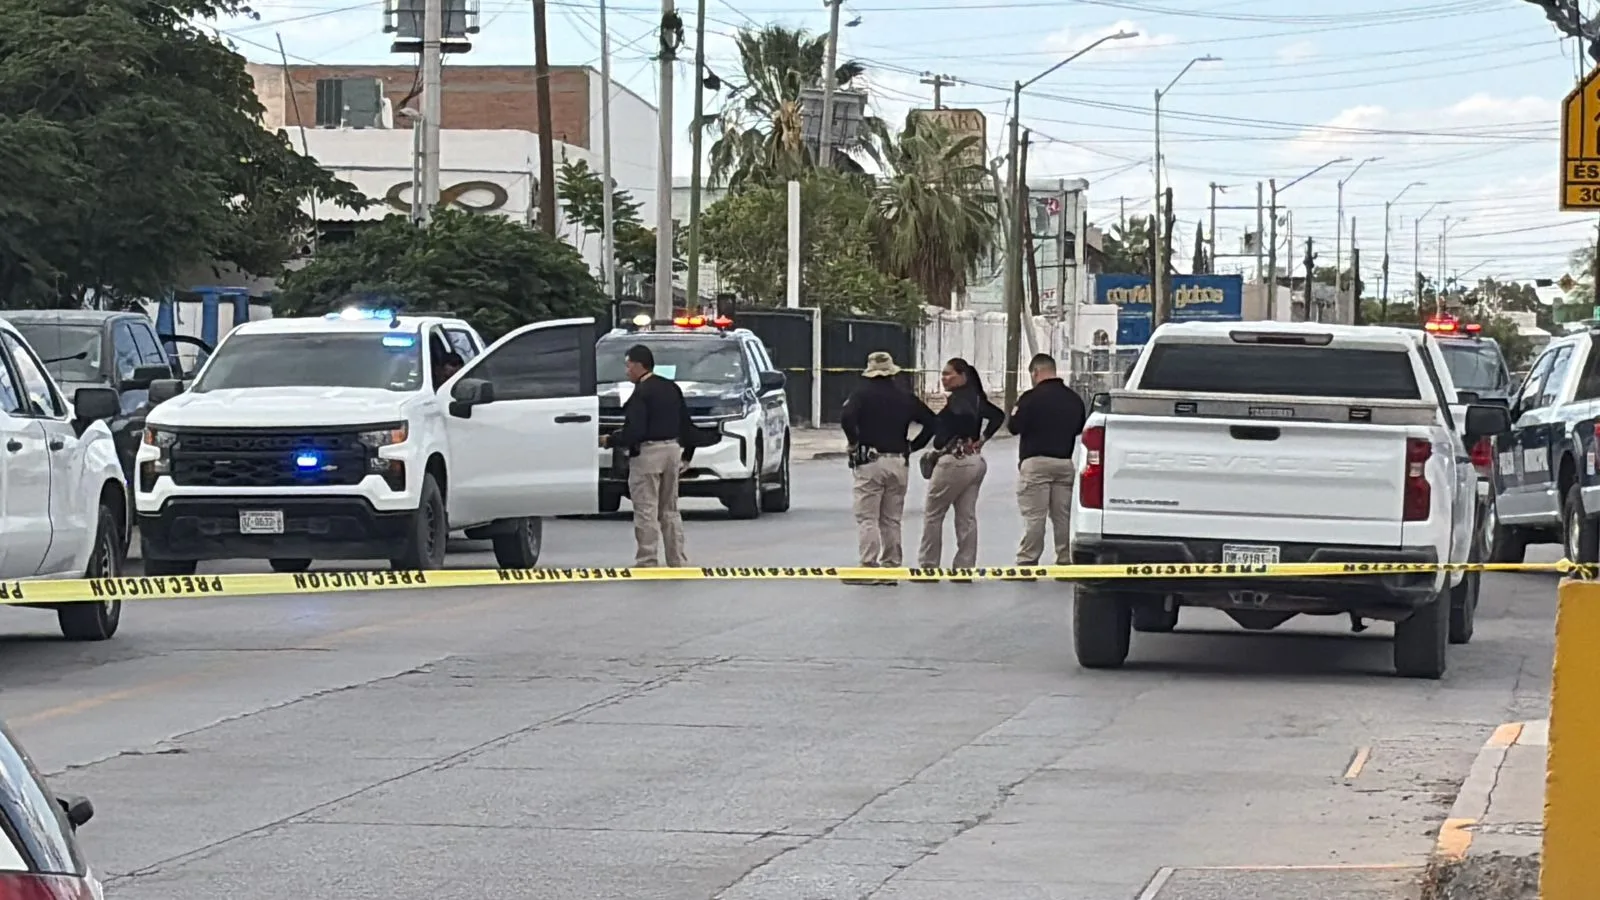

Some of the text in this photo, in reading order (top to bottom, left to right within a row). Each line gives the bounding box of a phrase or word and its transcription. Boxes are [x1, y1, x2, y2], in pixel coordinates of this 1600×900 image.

[1574, 164, 1599, 179] ES
[293, 570, 427, 589] PRECAUCION
[497, 568, 632, 580] PRECAUCION
[90, 576, 223, 596] PRECAUCION
